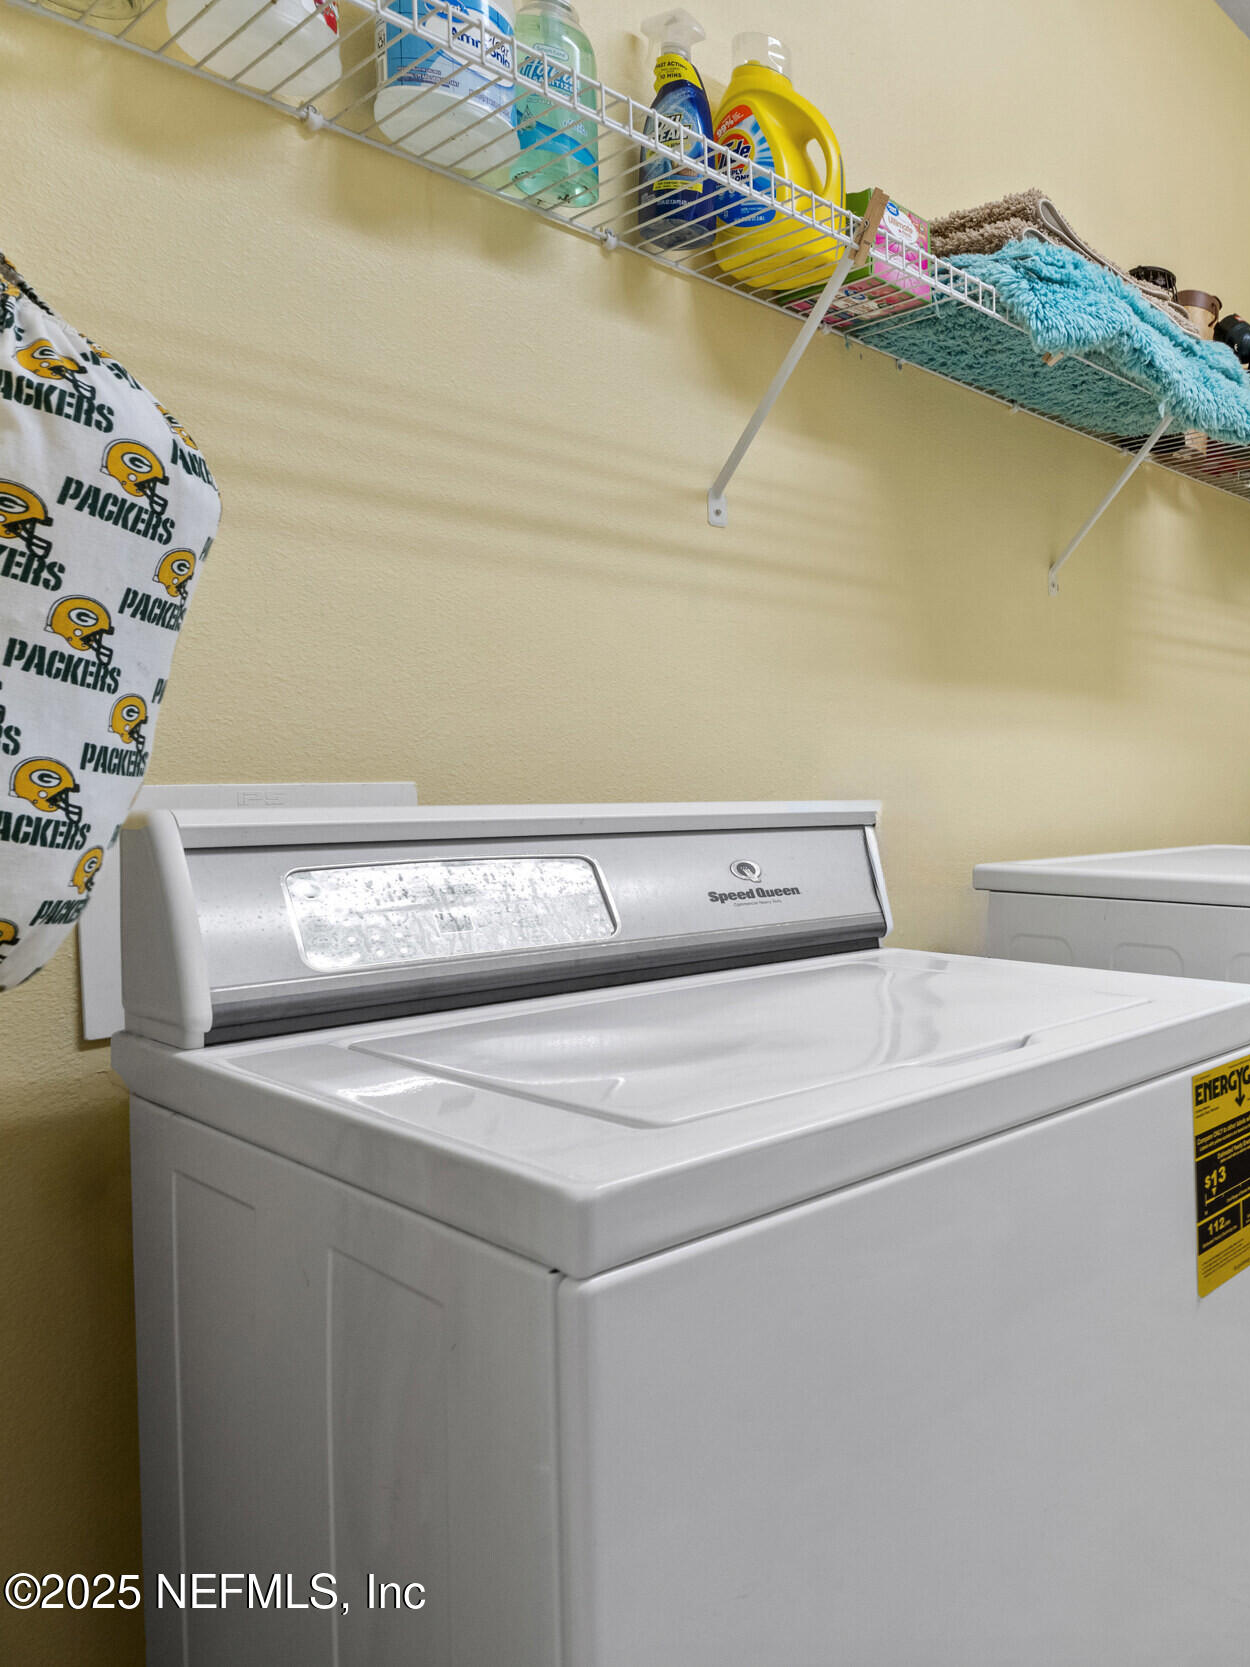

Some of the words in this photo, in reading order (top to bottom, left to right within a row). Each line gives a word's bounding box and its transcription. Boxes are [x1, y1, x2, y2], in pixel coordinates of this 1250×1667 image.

[56, 475, 176, 546] PACKERS
[3, 637, 121, 695] PACKERS
[80, 742, 149, 777] PACKERS
[708, 889, 756, 904] Speed
[756, 887, 801, 898] Queen
[1204, 1165, 1227, 1189] $13
[1207, 1216, 1225, 1236] 112
